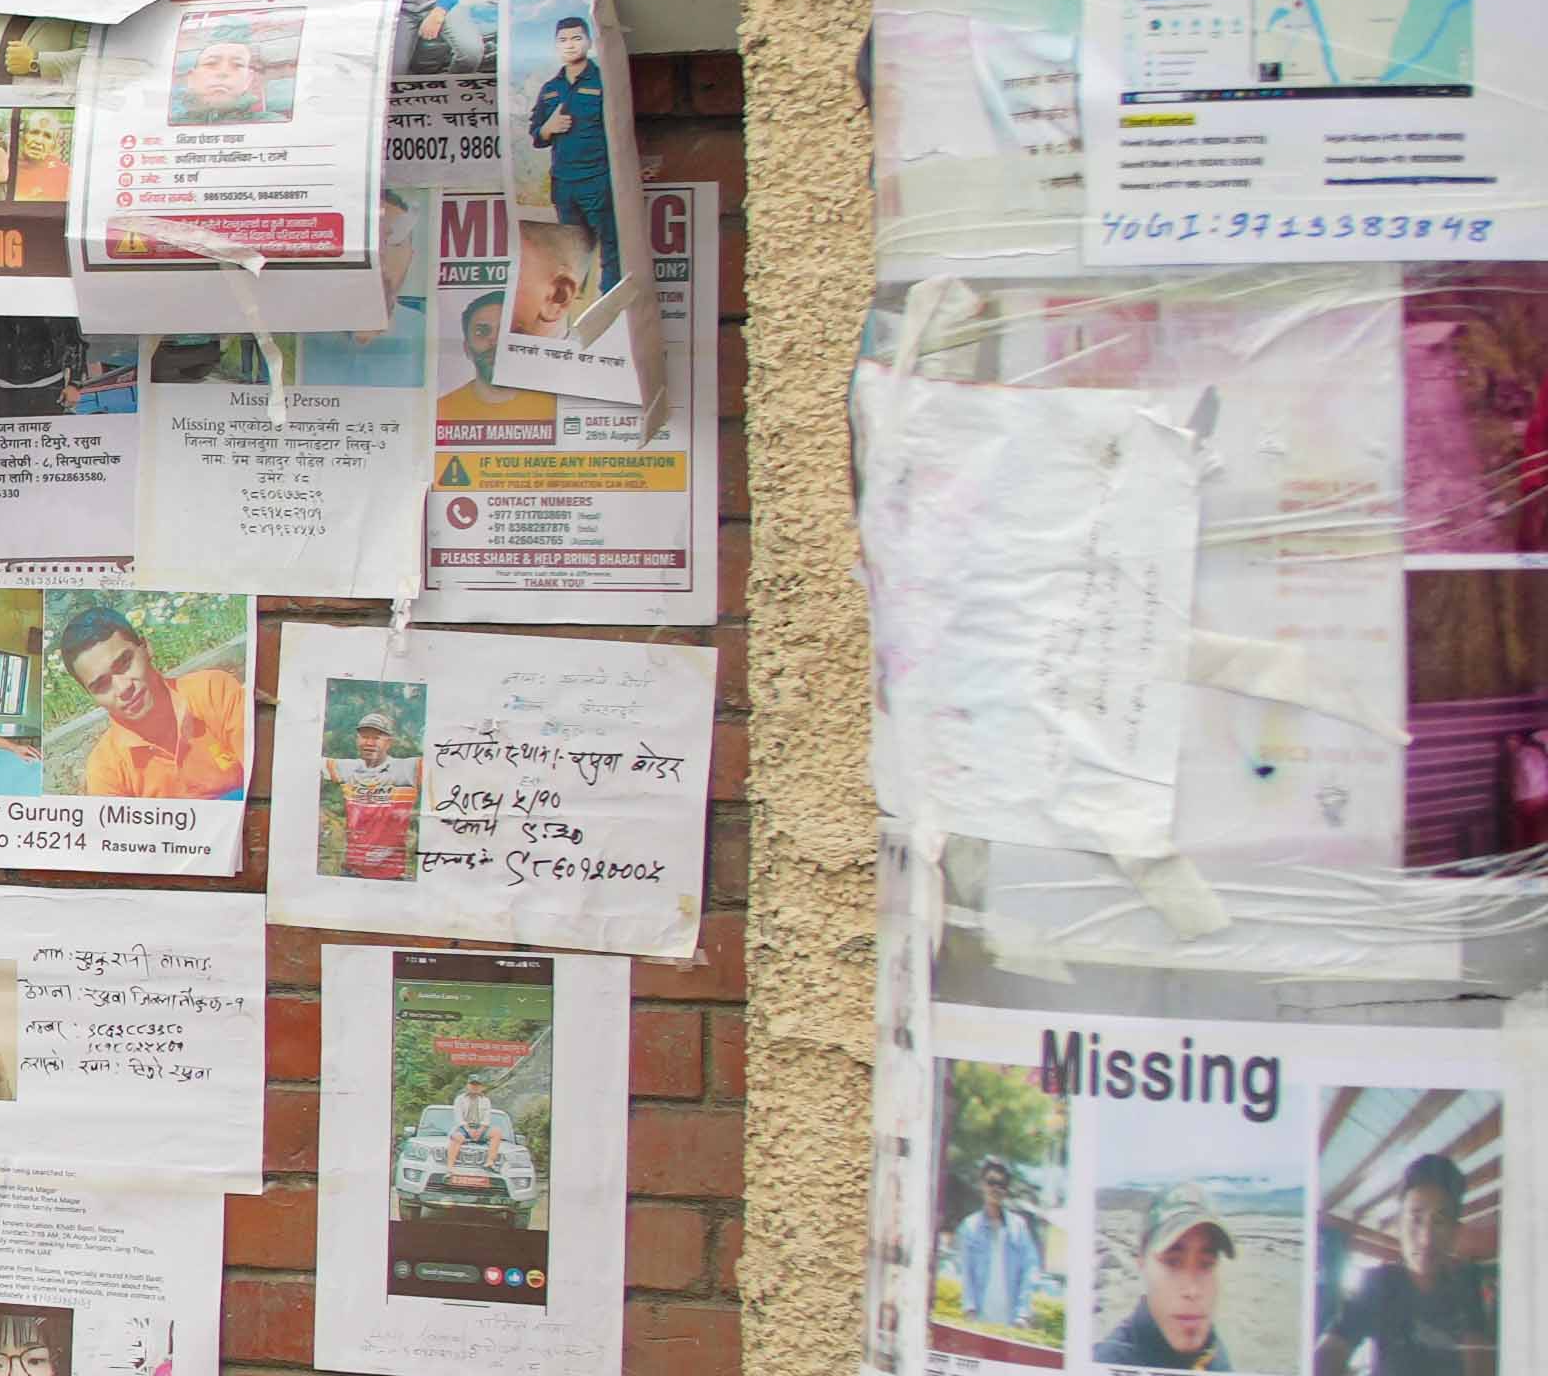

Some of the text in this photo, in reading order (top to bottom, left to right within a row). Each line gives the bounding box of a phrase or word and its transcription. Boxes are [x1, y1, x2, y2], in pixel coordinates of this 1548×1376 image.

[292, 393, 340, 409] Person
[437, 425, 553, 441] BHARAT MANGWANI
[488, 496, 593, 507] CONTACT NUMBERS
[441, 552, 676, 566] PLEASE SHARE & HELP BRING BHARAT HOME
[8, 803, 84, 825] Gurung
[99, 806, 196, 830] (Missing)
[102, 839, 212, 855] Rasuwa Timure
[1041, 1030, 1281, 1123] Missing
